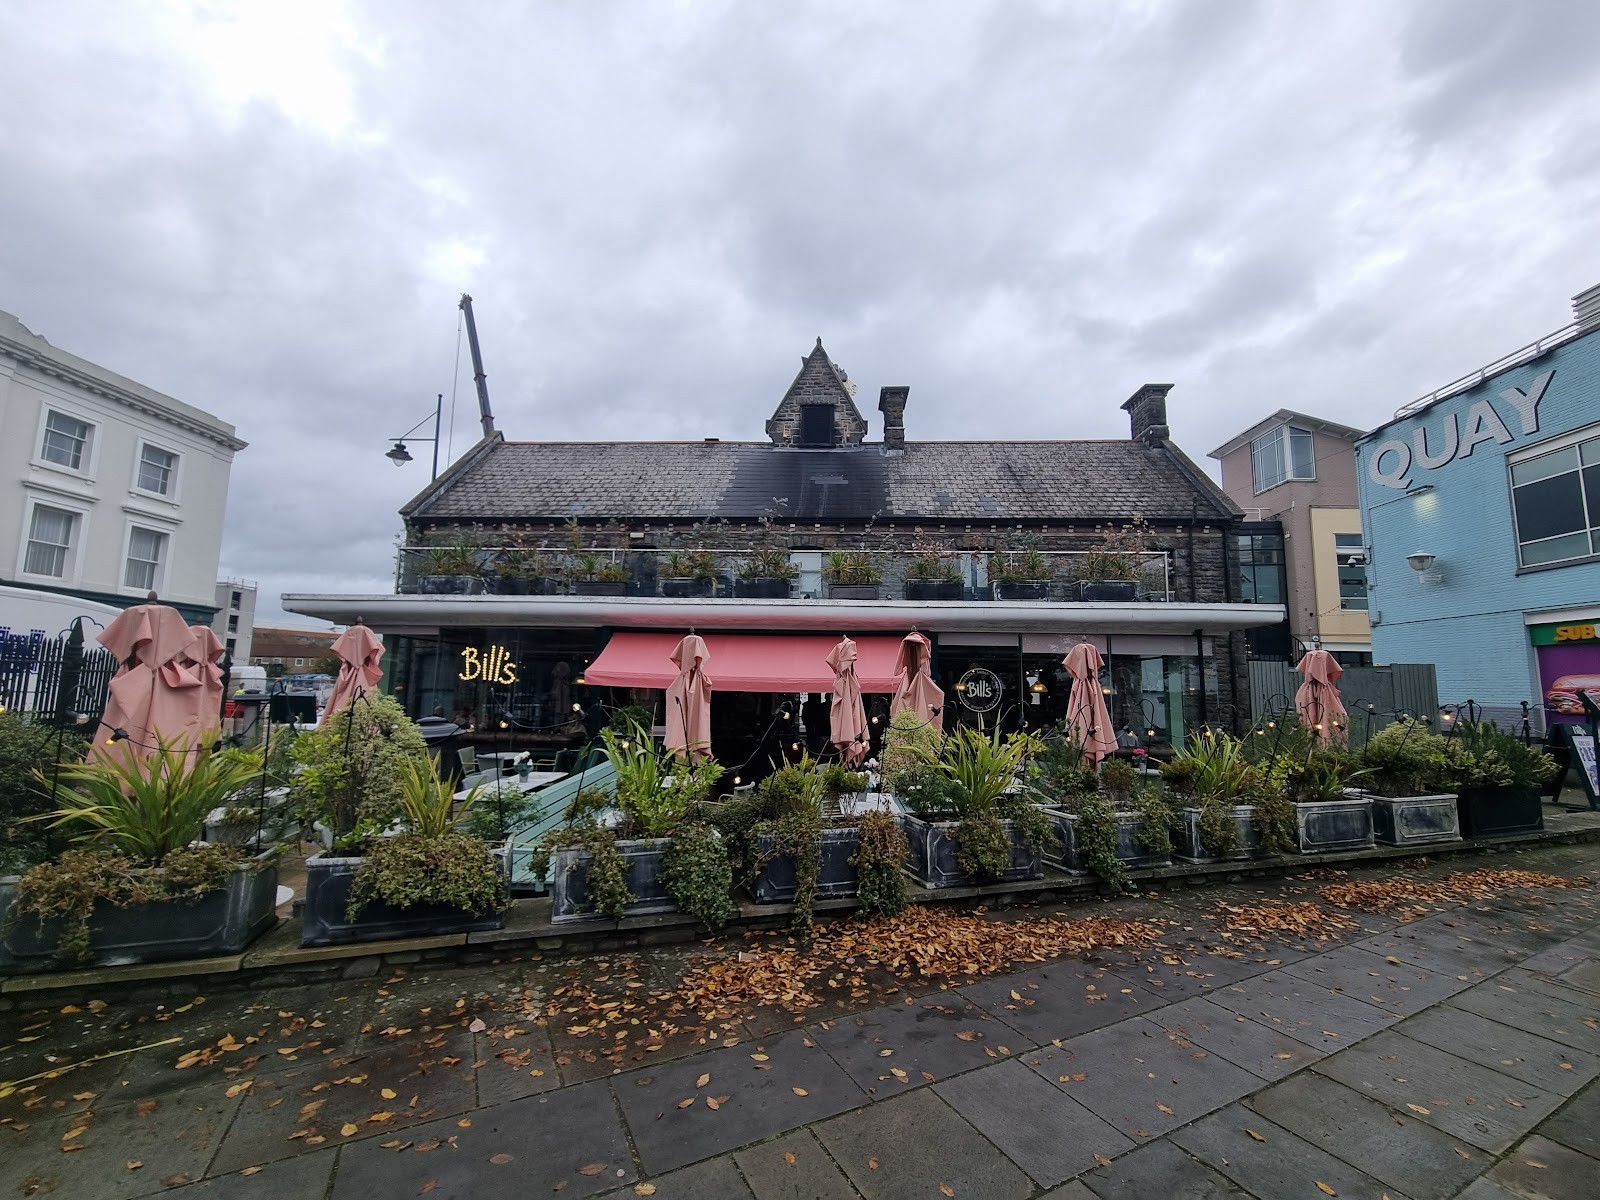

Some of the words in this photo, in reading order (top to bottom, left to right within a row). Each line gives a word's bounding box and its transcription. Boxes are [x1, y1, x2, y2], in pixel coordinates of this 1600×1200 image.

[1368, 370, 1557, 490] QUAY
[459, 644, 516, 685] Bill's
[967, 680, 993, 698] Bill's
